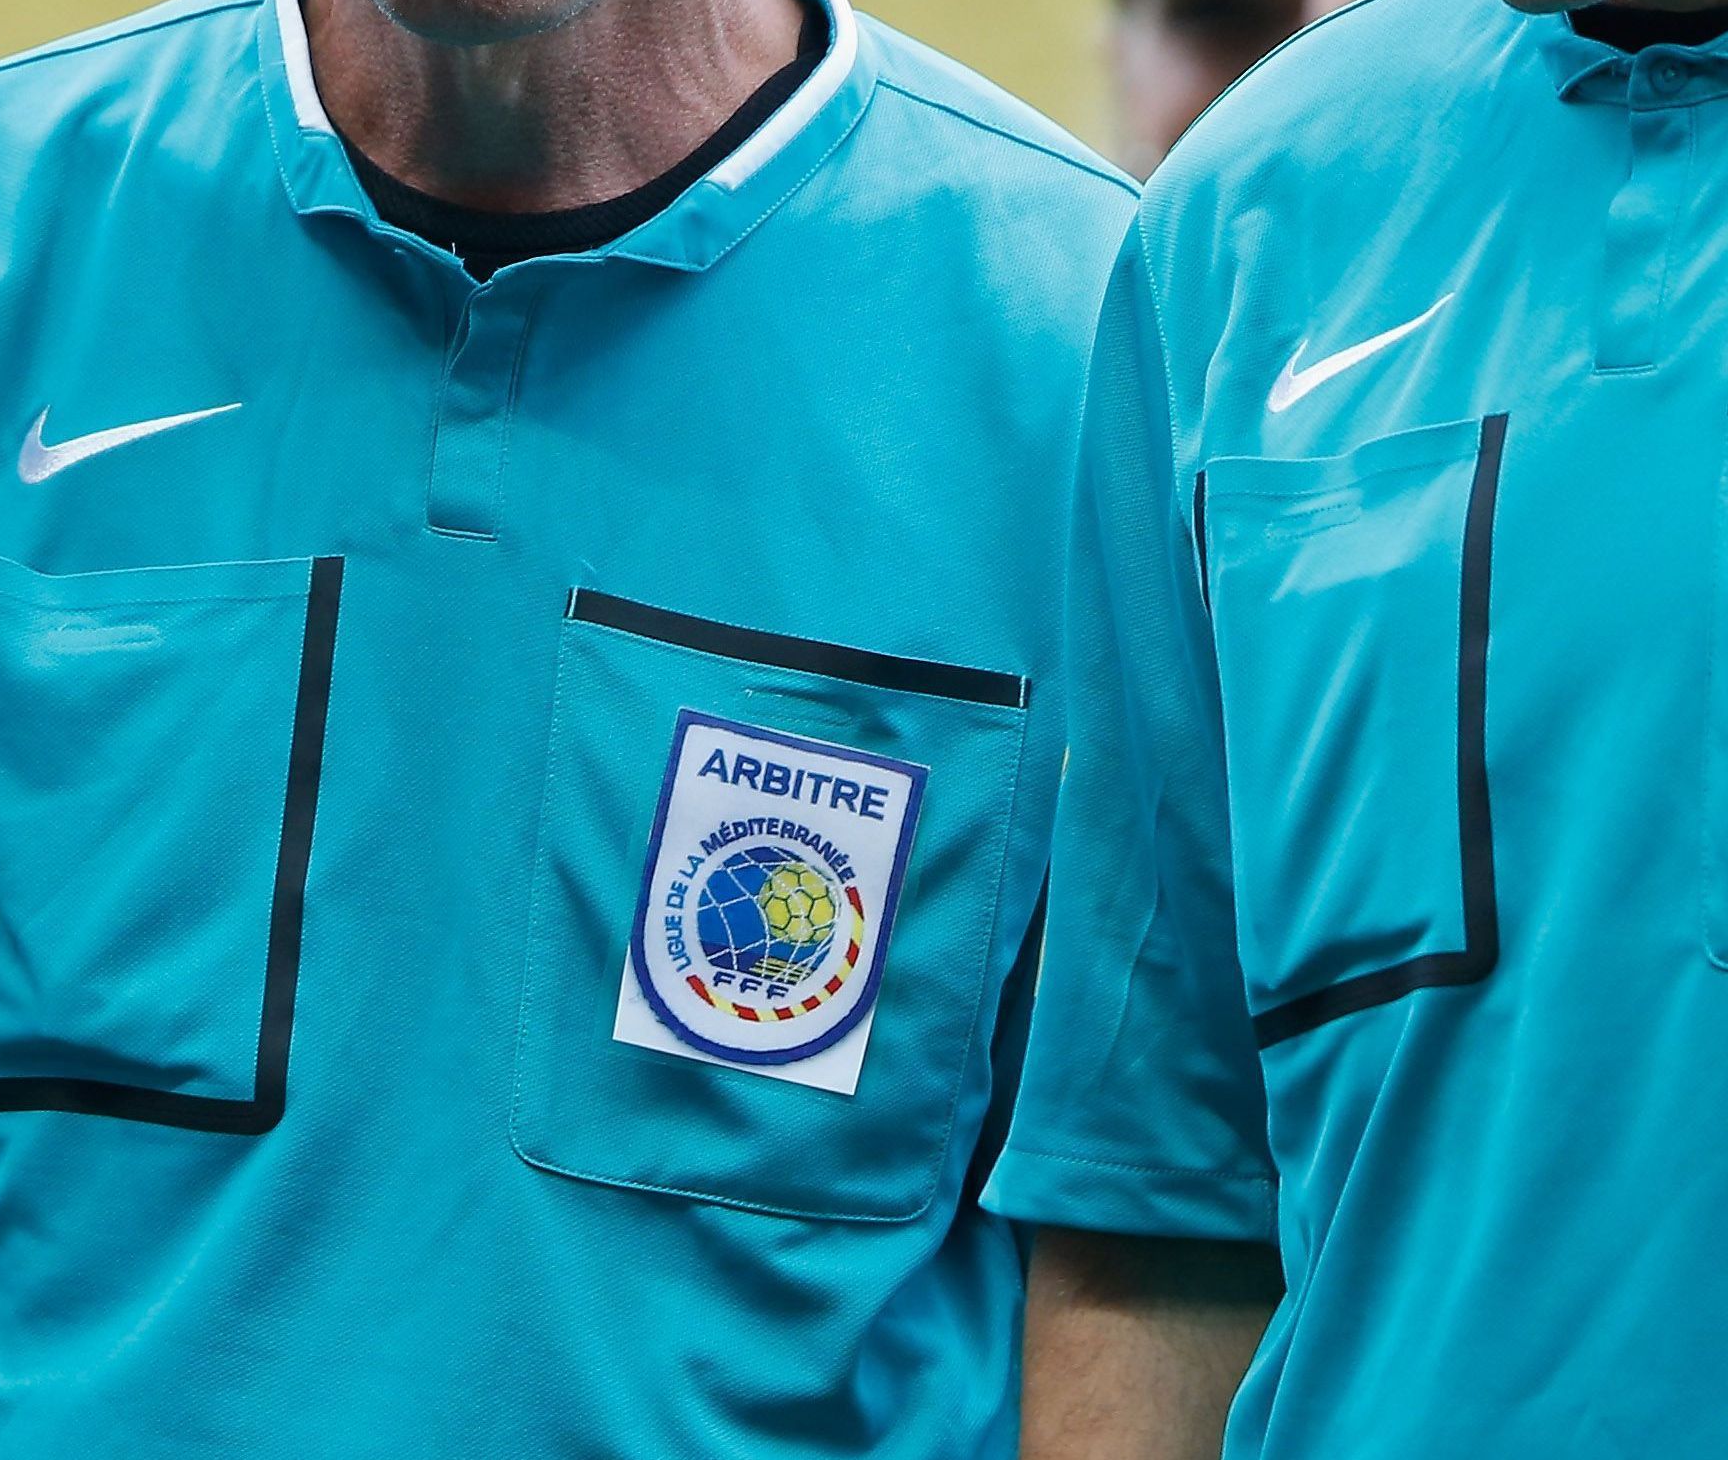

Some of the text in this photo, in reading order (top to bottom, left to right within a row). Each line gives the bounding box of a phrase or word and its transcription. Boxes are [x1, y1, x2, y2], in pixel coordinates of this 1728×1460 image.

[697, 748, 890, 820] ARBITRE
[665, 817, 857, 972] LIGUE DE LA MÉDITERRANÉE
